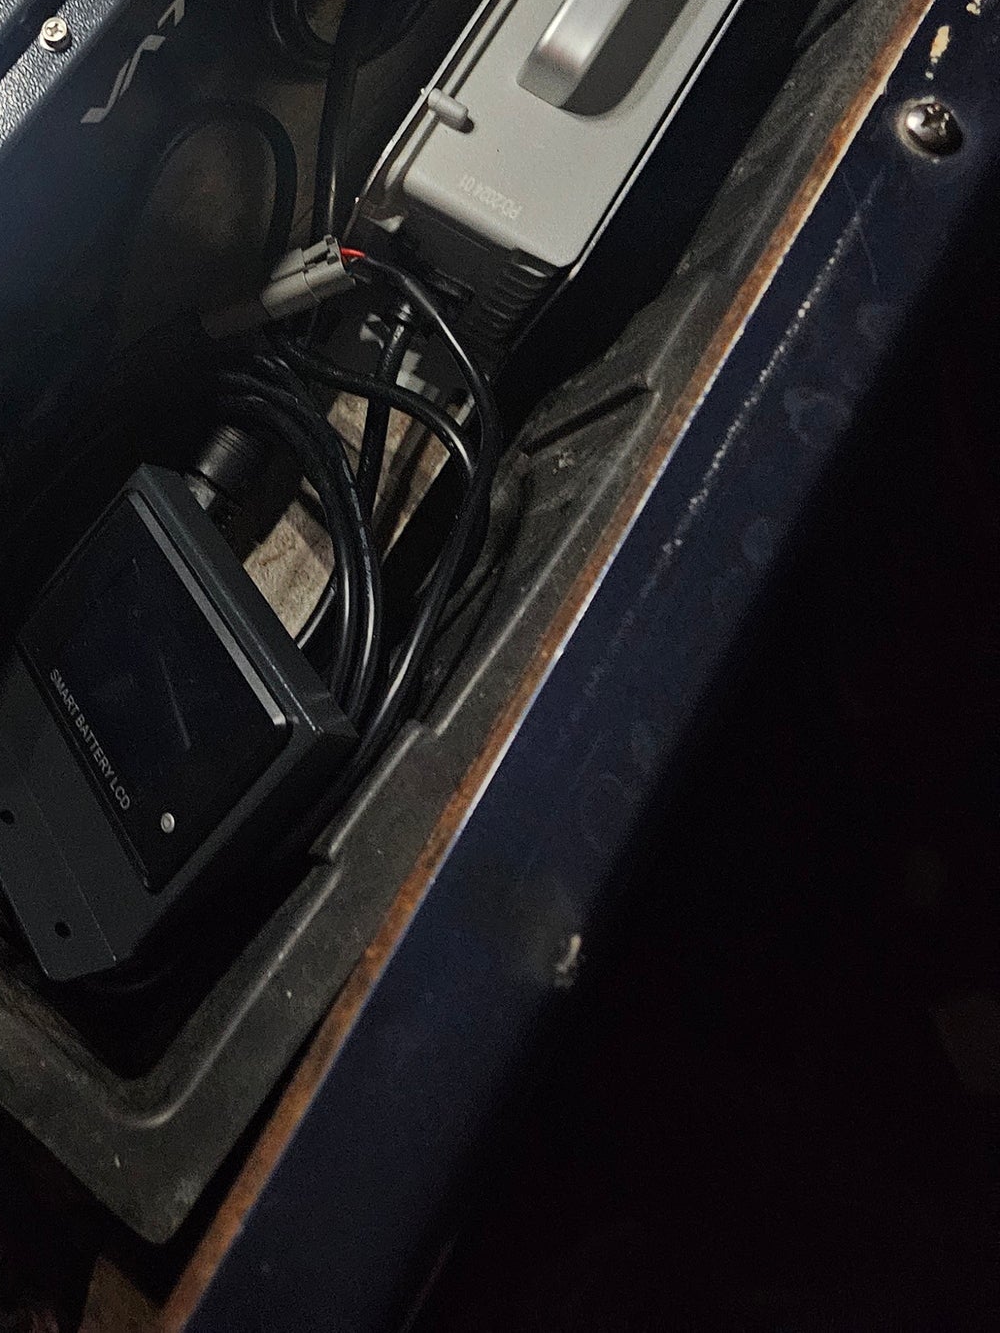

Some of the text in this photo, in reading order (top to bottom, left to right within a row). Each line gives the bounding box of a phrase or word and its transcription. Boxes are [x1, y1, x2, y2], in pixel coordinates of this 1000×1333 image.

[49, 668, 131, 811] SMART BATTERY LCD
